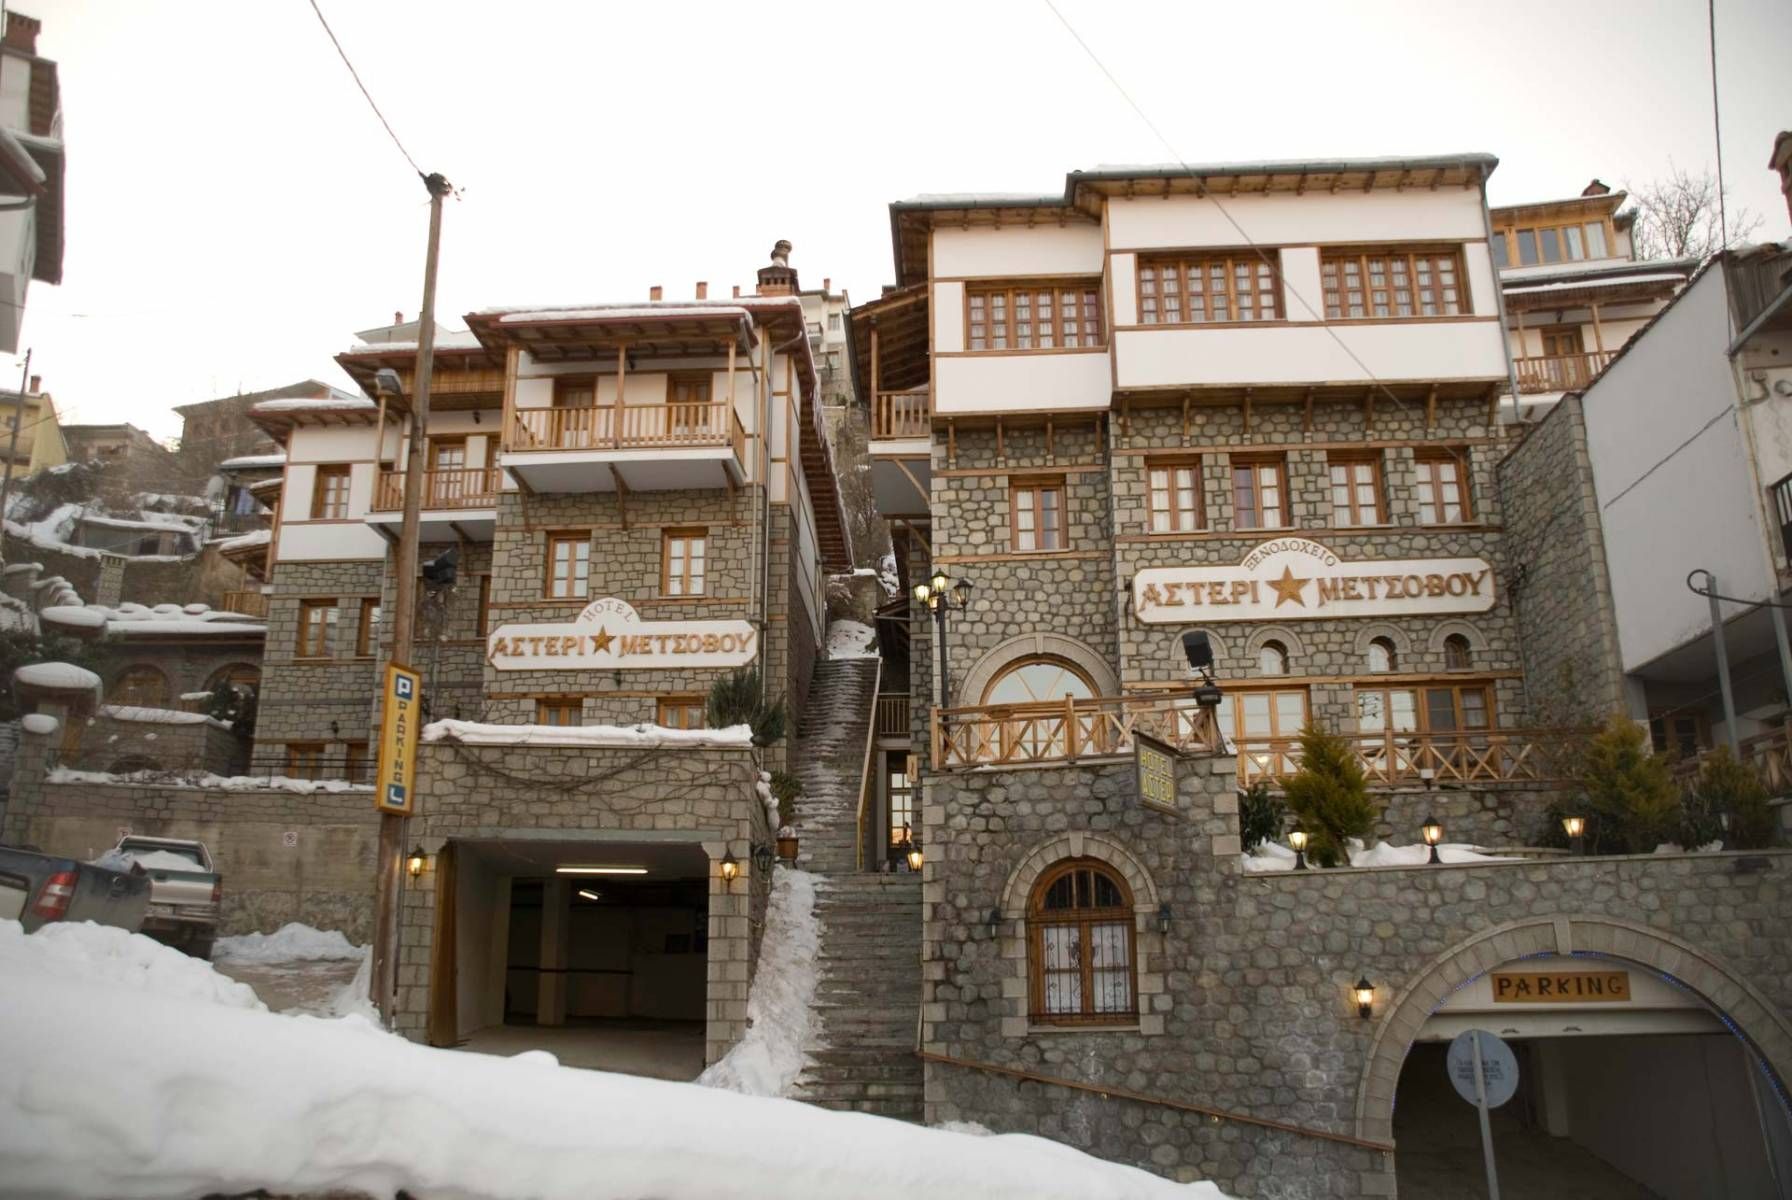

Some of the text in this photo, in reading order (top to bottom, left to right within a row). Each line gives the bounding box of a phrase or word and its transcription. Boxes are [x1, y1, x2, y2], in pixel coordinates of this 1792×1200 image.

[1245, 542, 1337, 571] ΞΕΝΟΔΟΧΕΙΟ
[1139, 569, 1489, 612] ΑΣΤΕΡΙ ΜΕΤΣΟΒΟΥ
[583, 599, 632, 622] HOTEL
[490, 630, 754, 659] ΑΣΤΕΡΙ ΜΕΤΣΟΒΟΥ
[396, 677, 410, 695] P
[393, 701, 408, 784] PARKING
[1497, 976, 1623, 997] PARKING
